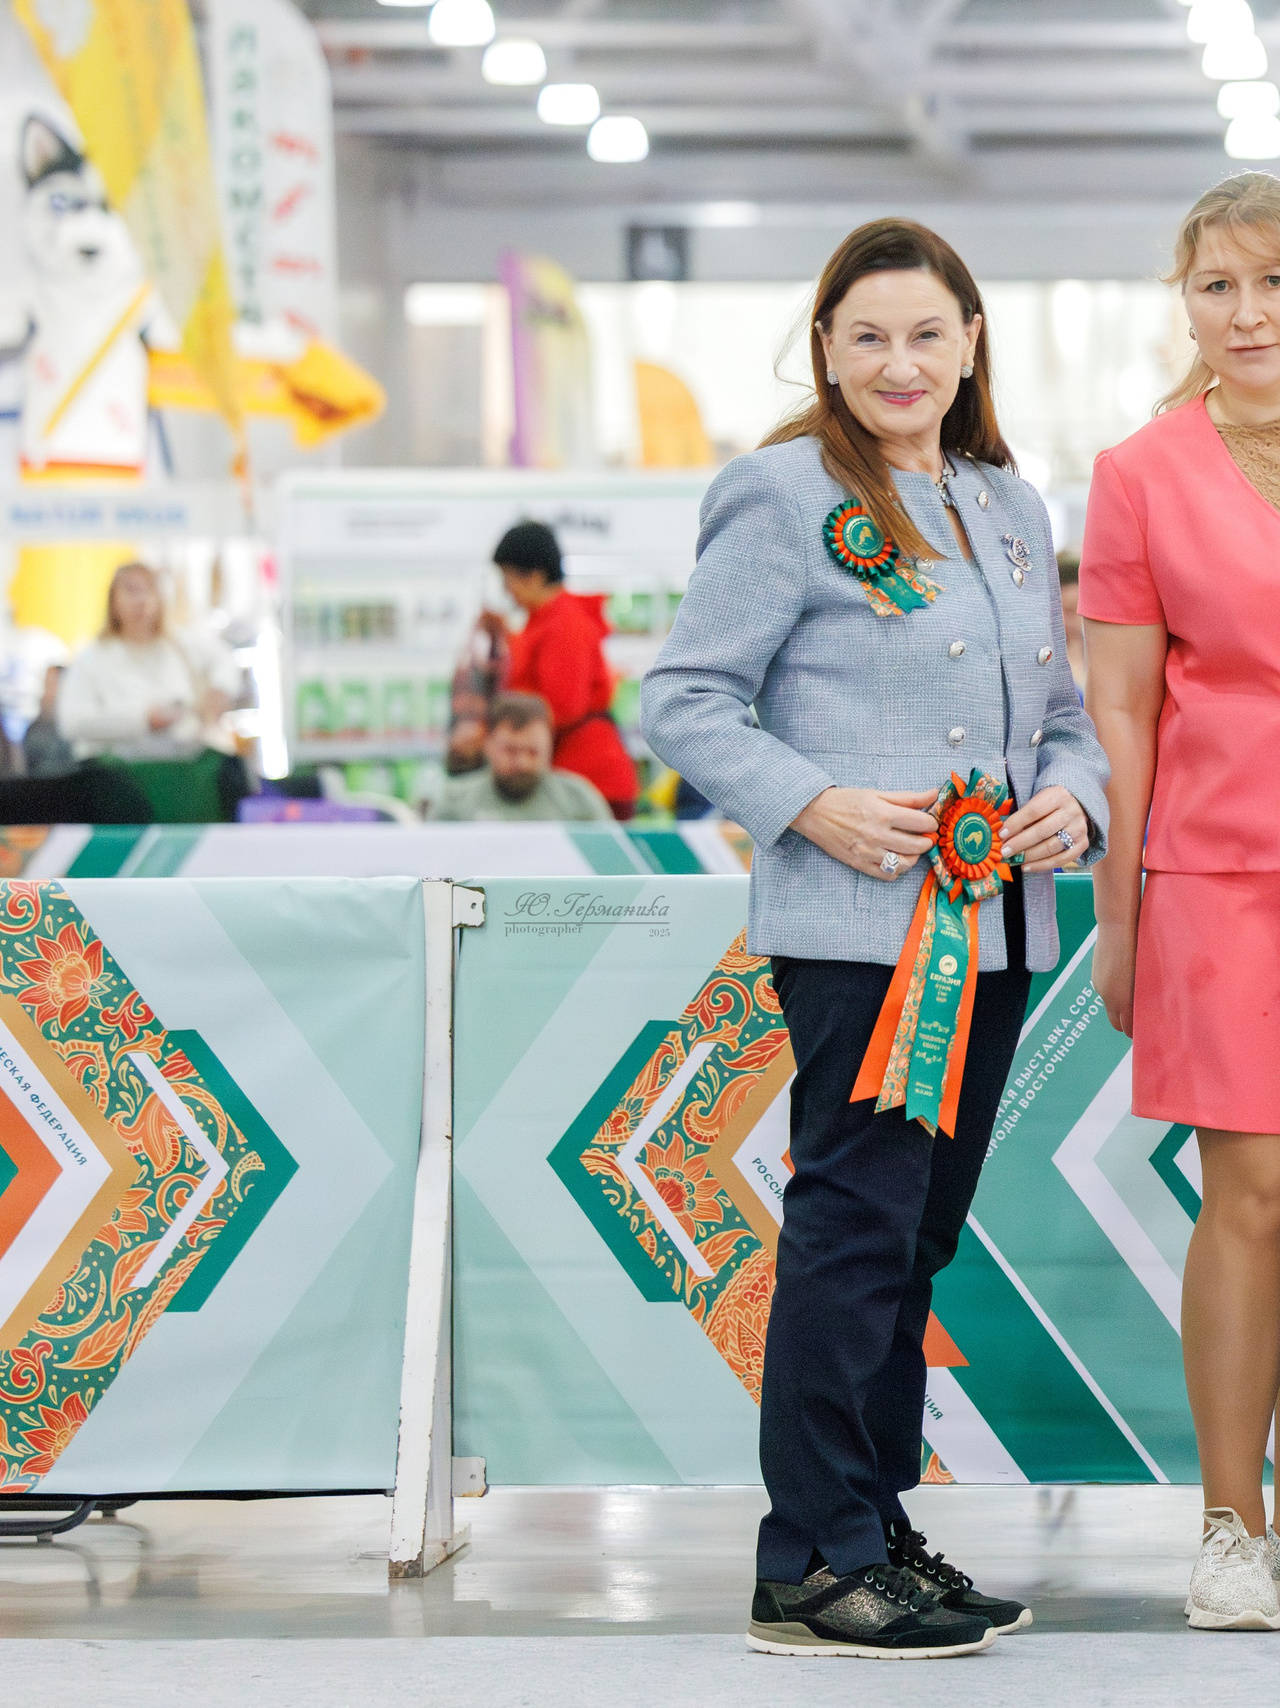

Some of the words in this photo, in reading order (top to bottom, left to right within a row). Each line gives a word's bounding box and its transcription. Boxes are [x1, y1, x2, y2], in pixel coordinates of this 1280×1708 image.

[0, 1046, 31, 1092] ЕСКАЯ
[30, 1093, 88, 1166] ФЕДЕРАЦИЯ
[993, 1088, 1018, 1126] НАЯ
[1014, 1018, 1072, 1089] ВЫСТАВКА
[752, 1157, 784, 1202] РОССИ
